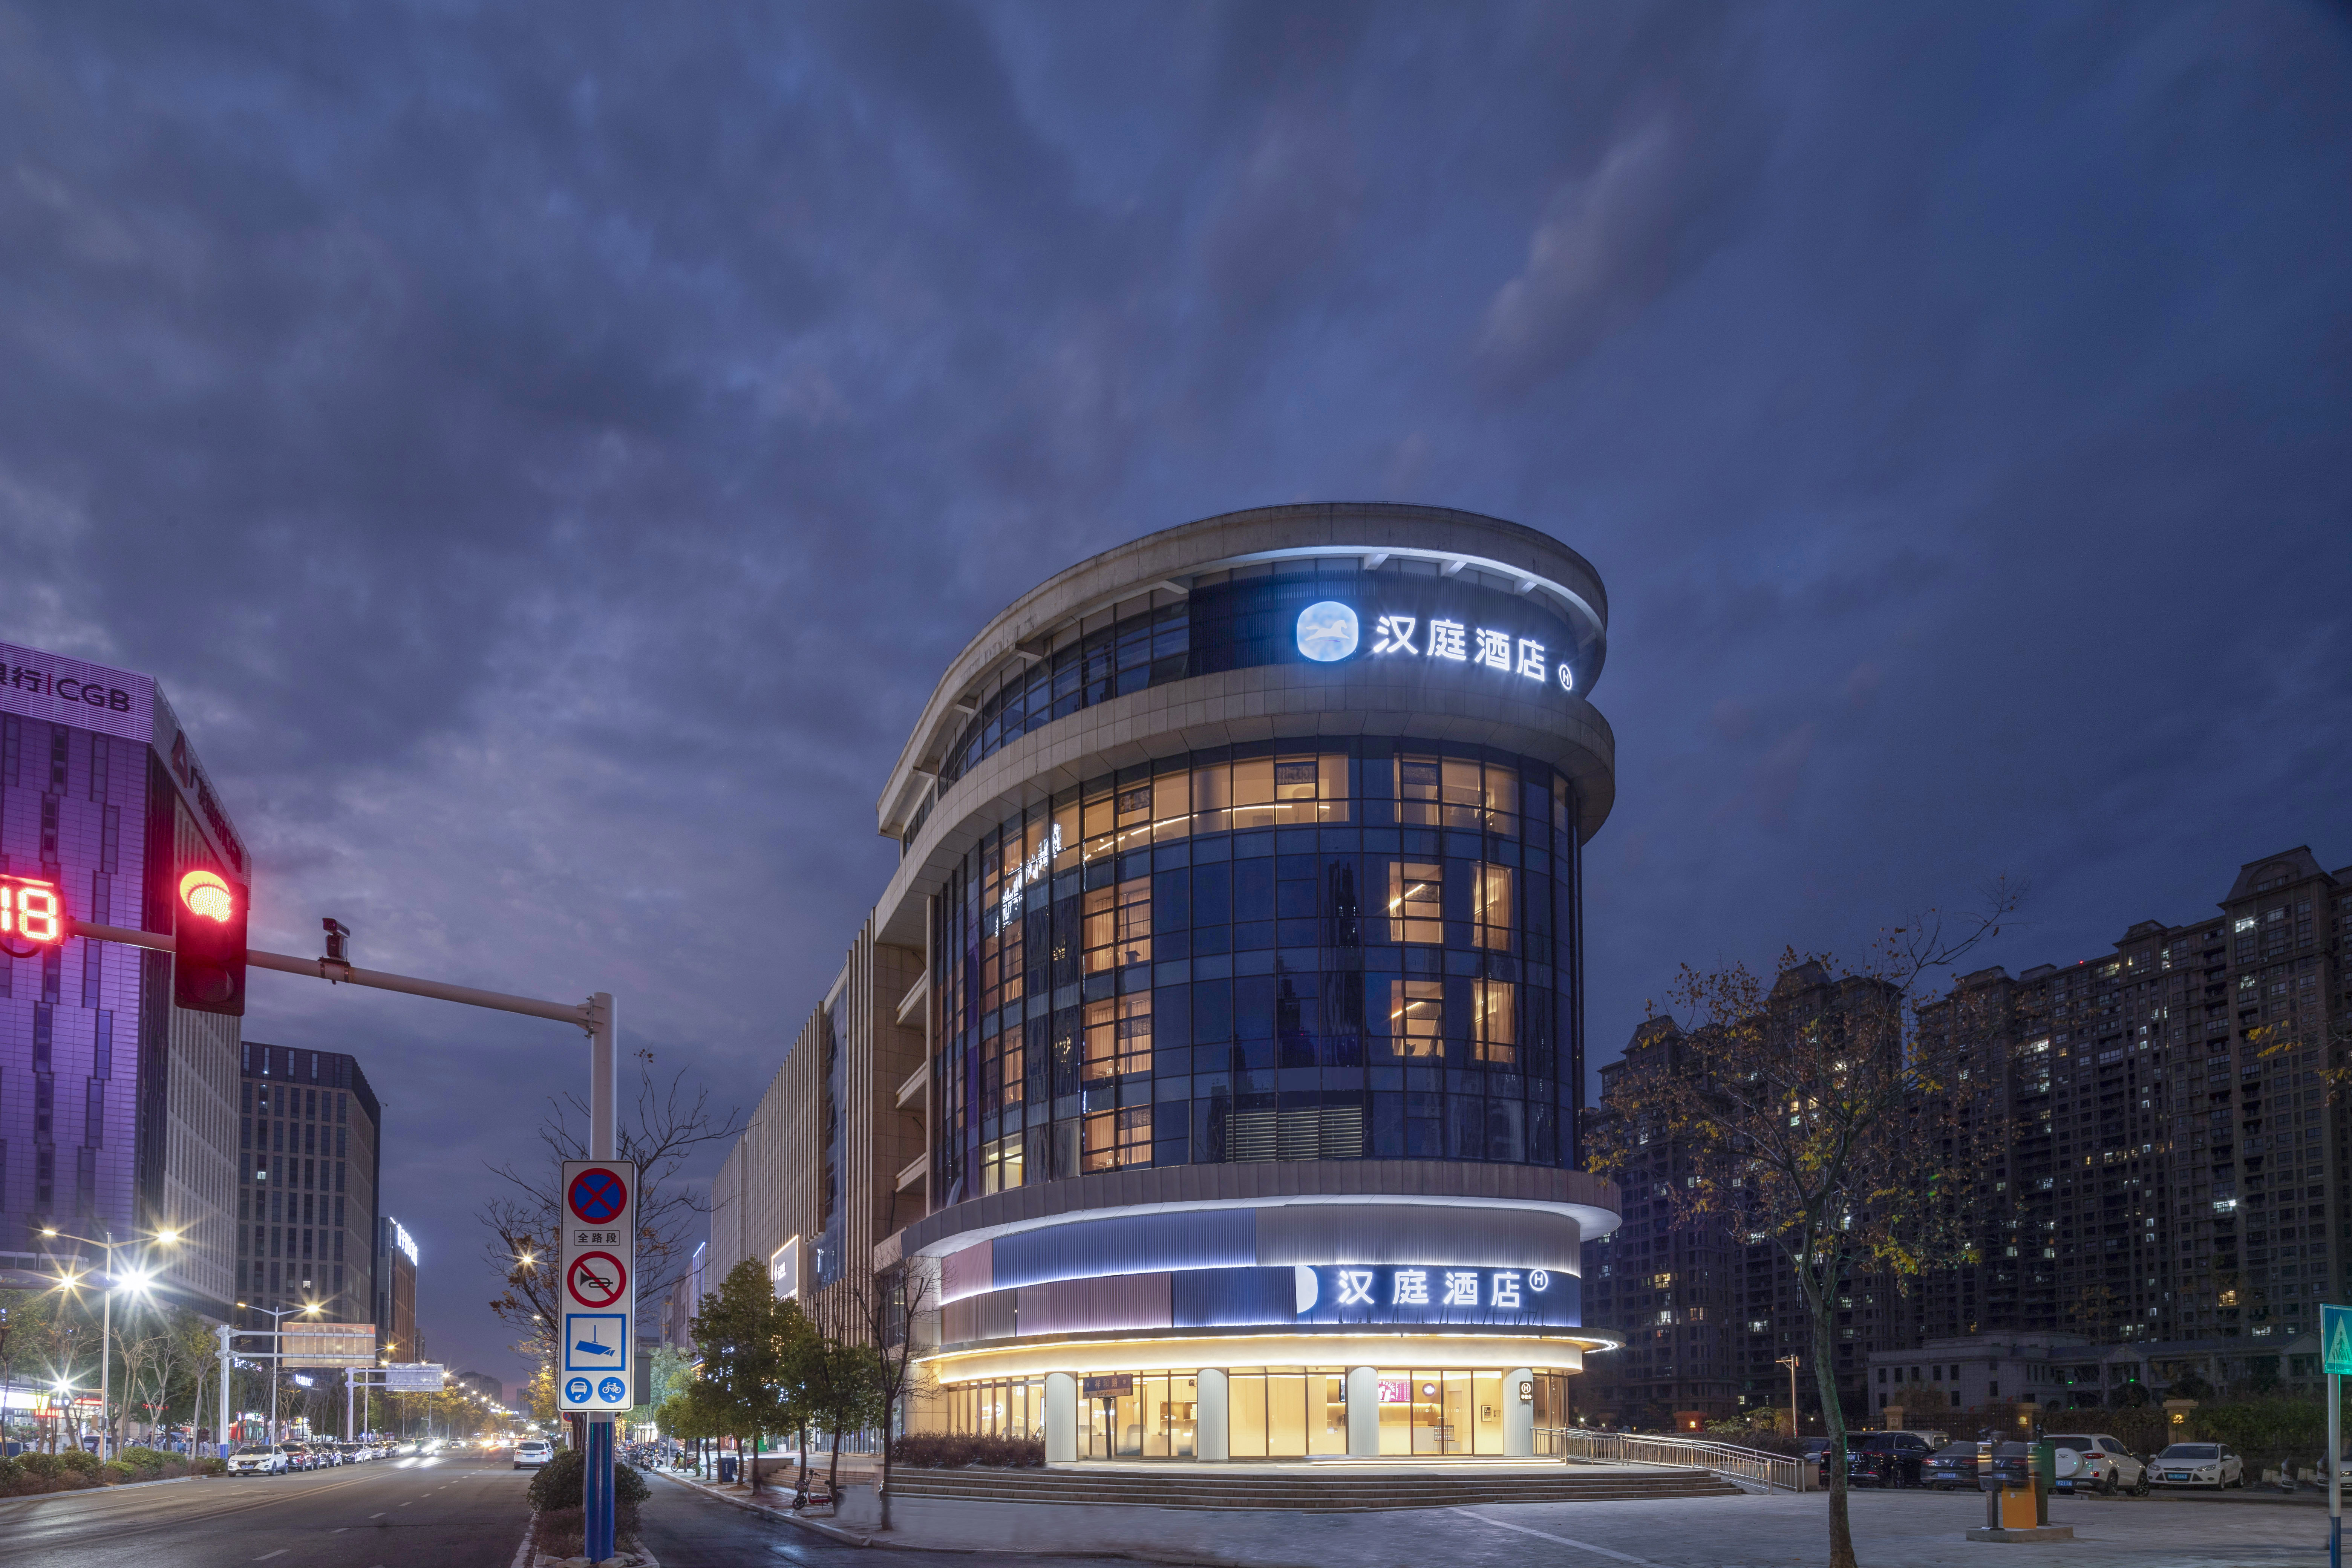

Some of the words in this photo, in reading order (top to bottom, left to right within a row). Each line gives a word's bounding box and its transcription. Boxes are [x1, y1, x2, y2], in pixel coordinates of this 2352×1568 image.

[1373, 616, 1545, 681] 汉庭酒店
[0, 663, 41, 692] 行
[56, 678, 130, 712] CGB
[1, 887, 57, 940] 18
[577, 1232, 617, 1243] 全路段
[1339, 1269, 1520, 1308] 汉庭酒店
[1095, 1378, 1118, 1389] 祥和路
